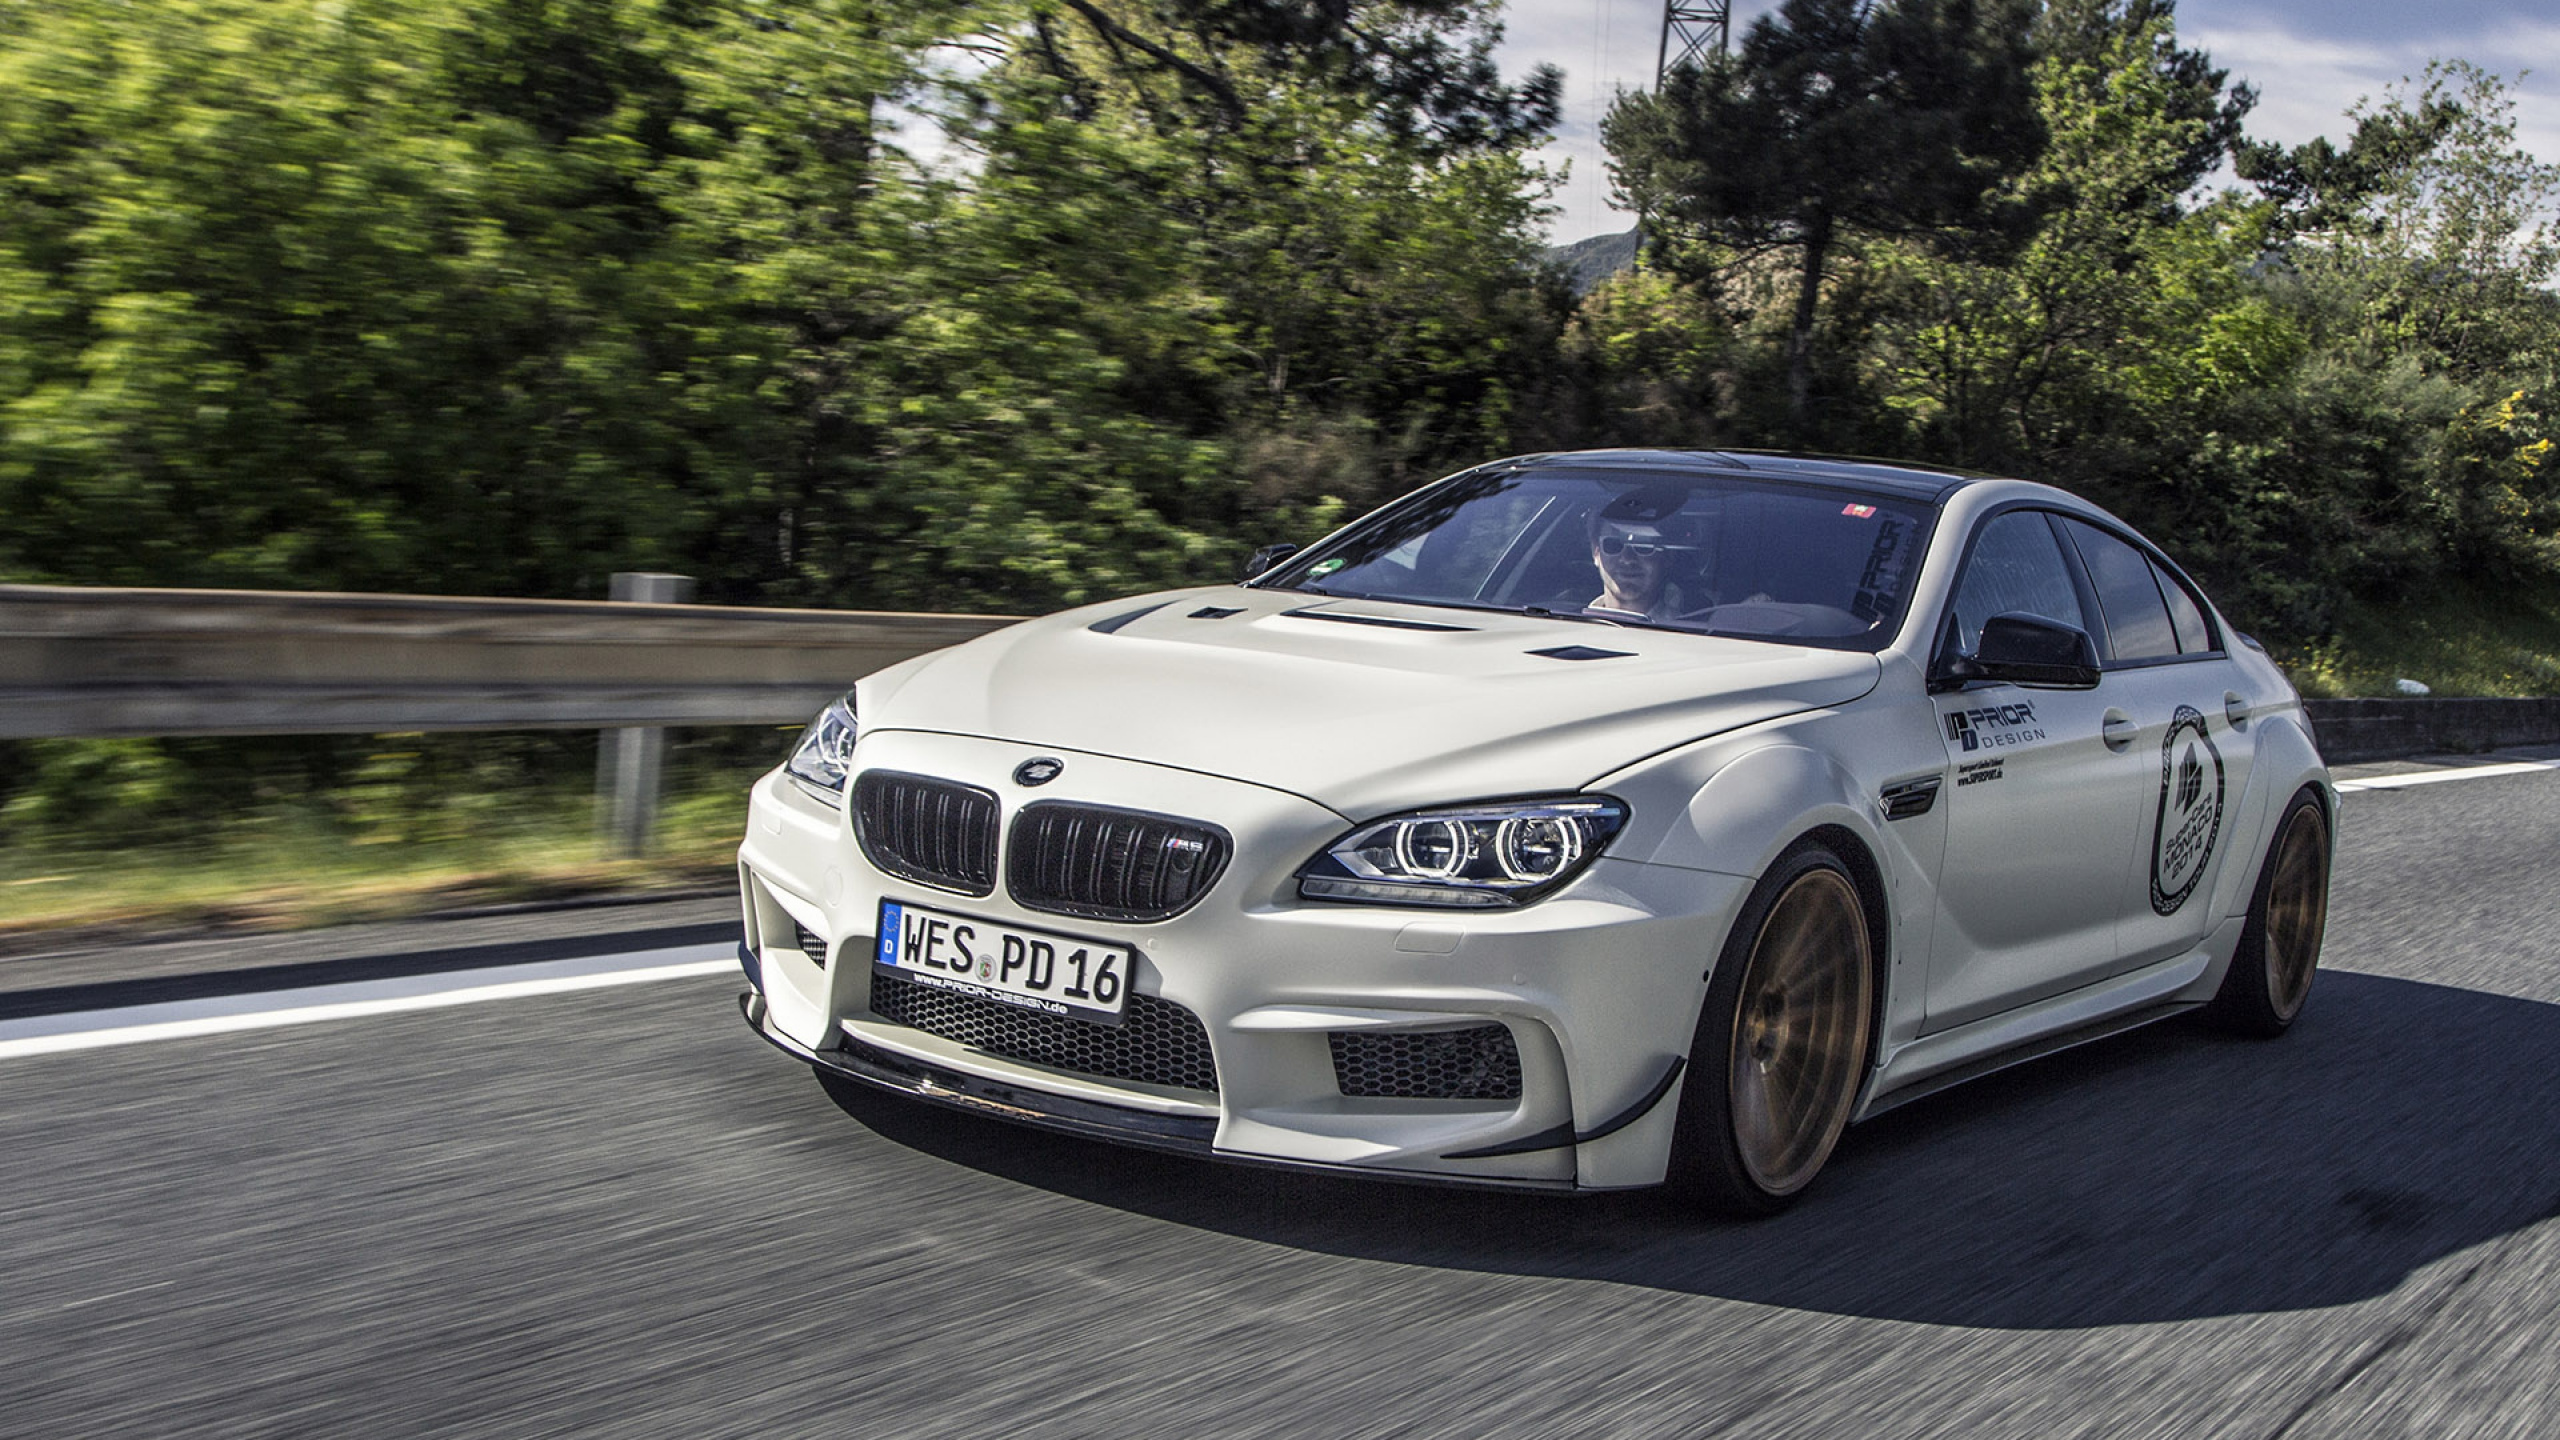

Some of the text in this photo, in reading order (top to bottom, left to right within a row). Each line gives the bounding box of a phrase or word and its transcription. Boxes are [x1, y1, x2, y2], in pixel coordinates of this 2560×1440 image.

[1965, 703, 2037, 731] PRIOR
[1981, 728, 2046, 749] DESIGN
[2163, 806, 2213, 874] MONACO
[2171, 835, 2202, 881] 2014
[884, 939, 894, 954] D
[904, 913, 1120, 1005] WES PD 16
[913, 973, 1069, 1014] www.PRIOR-DESIGN.de
